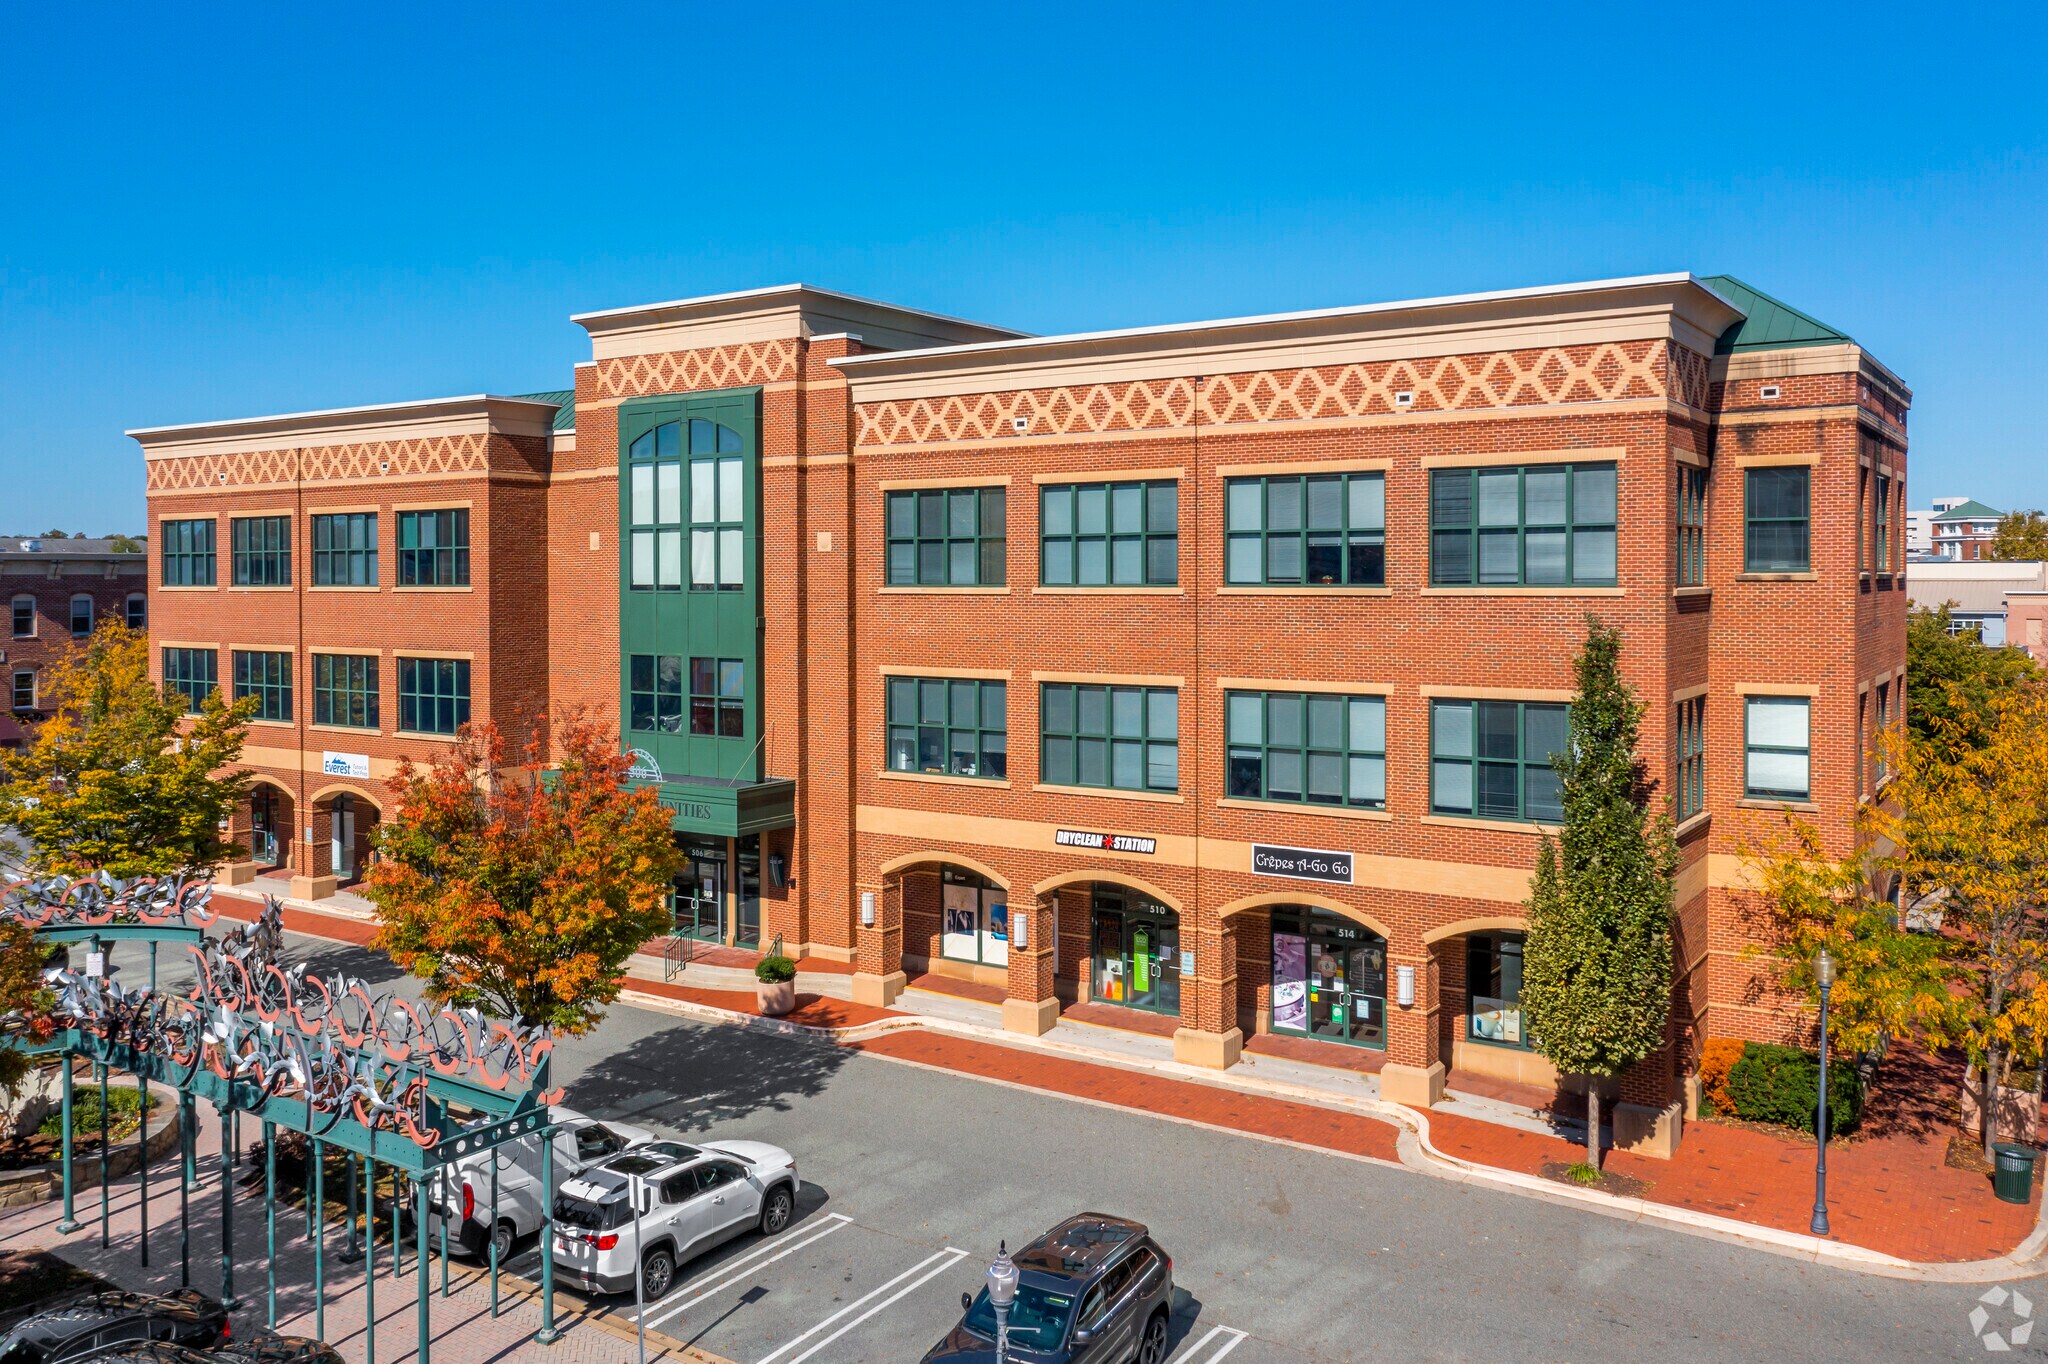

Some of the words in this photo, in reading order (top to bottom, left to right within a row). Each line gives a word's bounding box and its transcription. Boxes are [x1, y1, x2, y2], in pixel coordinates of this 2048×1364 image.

[324, 760, 351, 775] Everest
[1056, 830, 1104, 848] DRYCLEAN
[1113, 836, 1155, 853] STATION
[691, 849, 704, 857] 506
[1256, 853, 1294, 870] Crêpes
[1296, 858, 1328, 873] A-Go
[1332, 861, 1349, 875] Go
[1149, 905, 1166, 915] 510
[1338, 928, 1355, 939] 514
